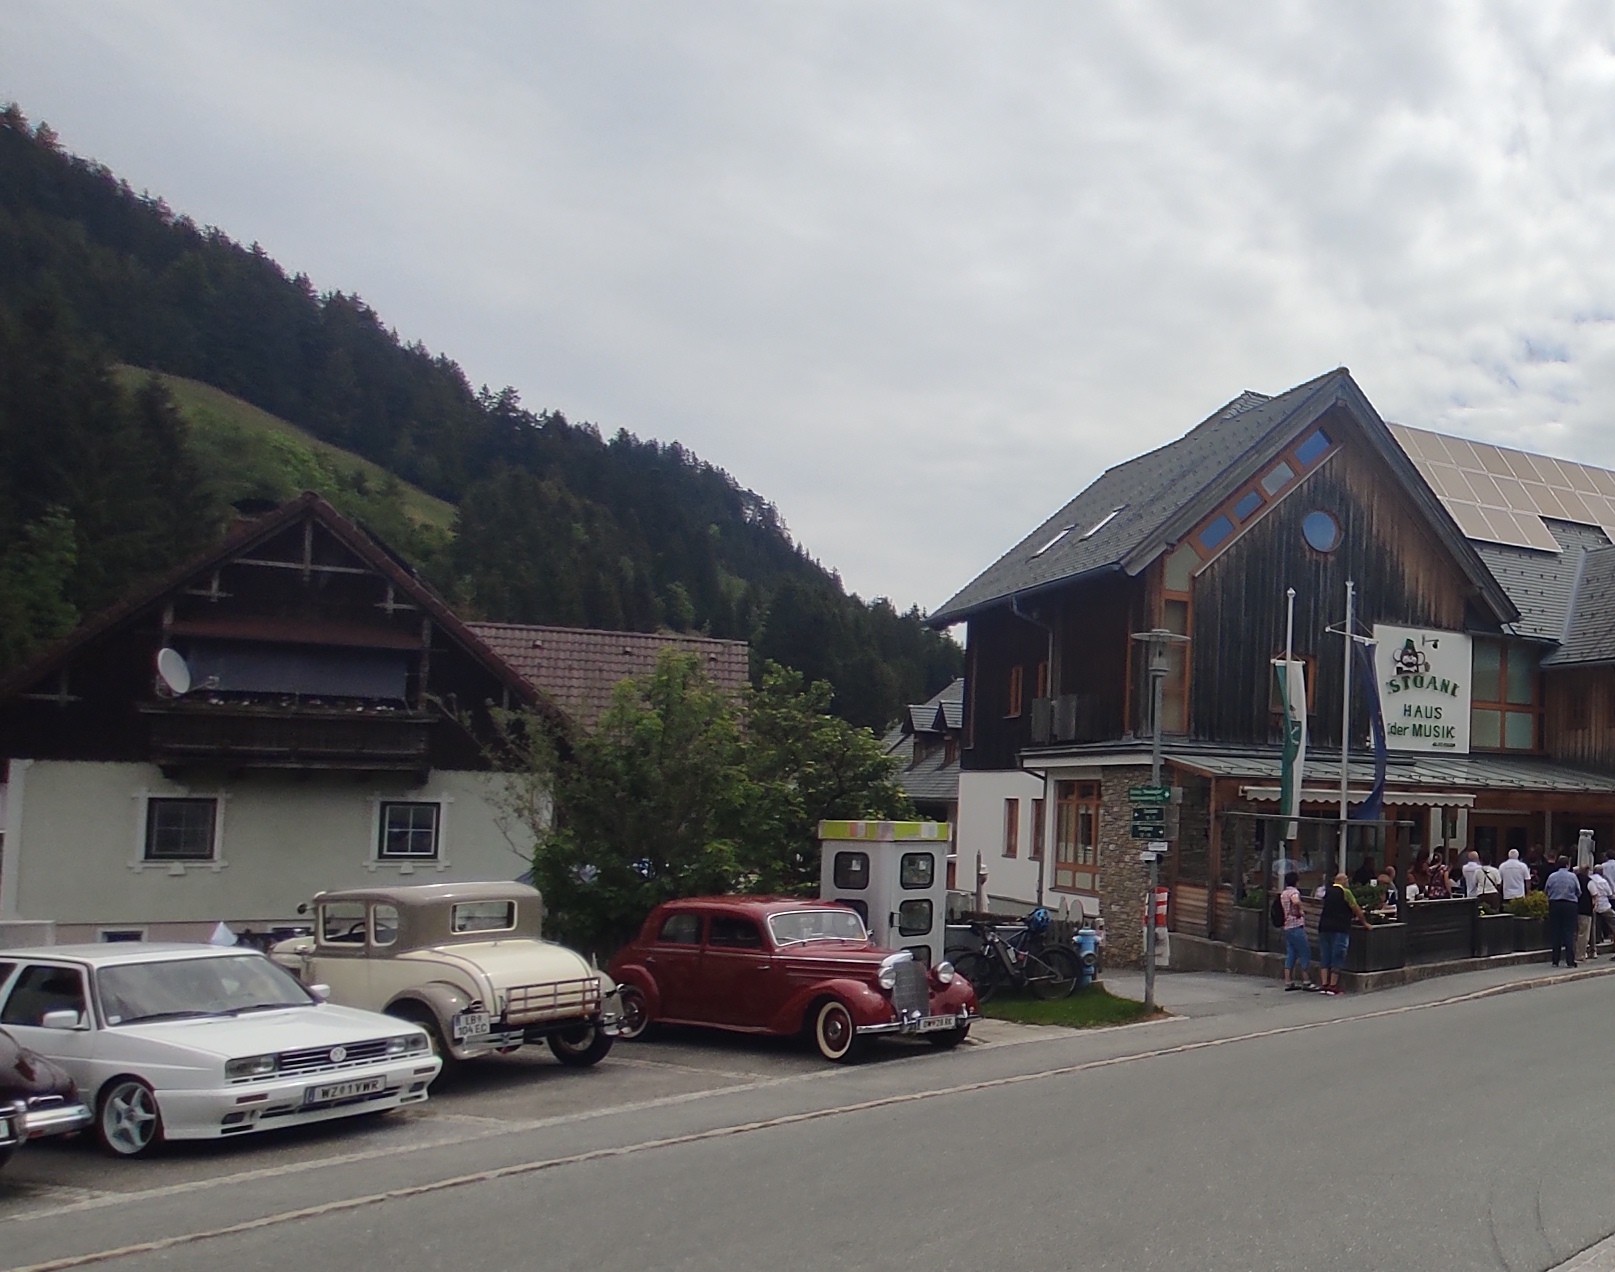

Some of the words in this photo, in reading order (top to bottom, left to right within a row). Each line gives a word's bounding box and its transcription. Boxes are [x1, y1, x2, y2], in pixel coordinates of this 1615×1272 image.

[1389, 675, 1459, 697] STOANI
[1403, 704, 1442, 719] HAUS
[1390, 722, 1409, 736] der
[1412, 724, 1456, 738] MUSIK
[321, 1086, 338, 1099] WZ
